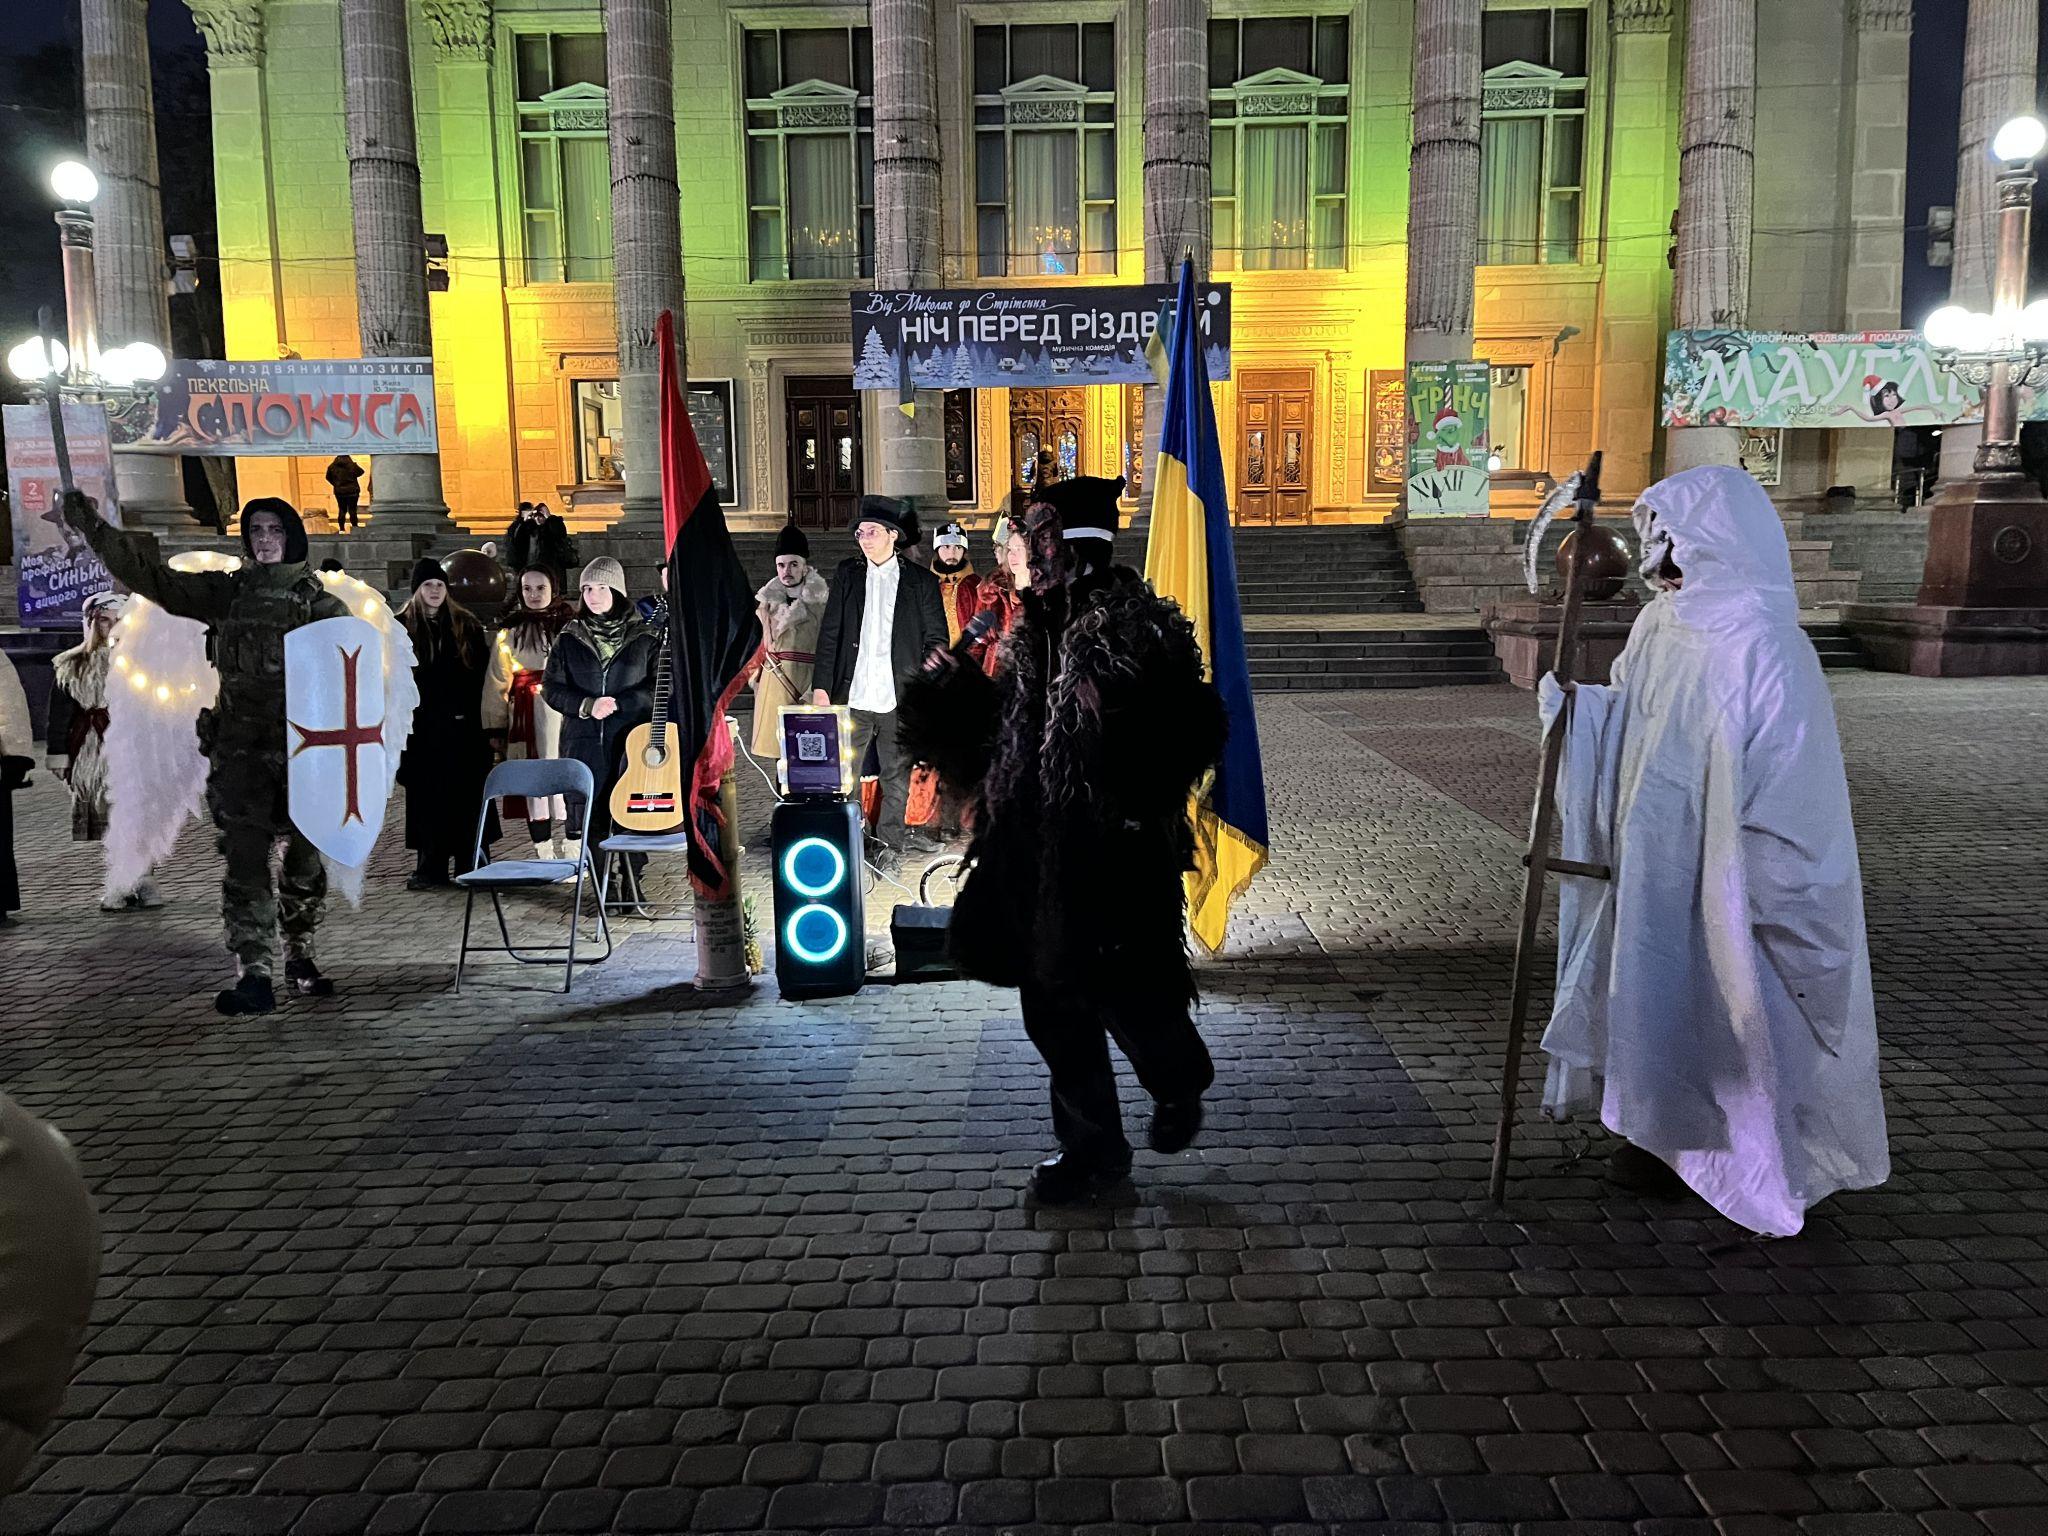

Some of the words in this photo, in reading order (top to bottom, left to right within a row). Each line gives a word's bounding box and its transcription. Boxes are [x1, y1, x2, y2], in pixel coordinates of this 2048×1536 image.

[866, 292, 892, 316] Від
[896, 292, 953, 312] Миколая
[958, 298, 970, 314] до
[901, 312, 949, 342] НІЧ
[959, 313, 1062, 345] ПЕРЕД
[1072, 308, 1211, 342] РІЗДВ
[1869, 332, 1925, 343] ПОДАРУНО
[1052, 345, 1084, 353] музична
[1085, 343, 1116, 352] комедія
[228, 364, 334, 376] РІЗДВЯНИЙ
[348, 364, 424, 374] МЮЗИКЛ
[187, 377, 270, 393] ПЕКЕЛЬНА
[187, 388, 427, 445] СПОКУСА
[1739, 435, 1776, 453] УГЛІ
[28, 482, 38, 496] 2
[21, 555, 43, 569] Моя
[49, 558, 108, 591] СИНЬЙО
[24, 602, 31, 612] з
[35, 589, 77, 609] вищого
